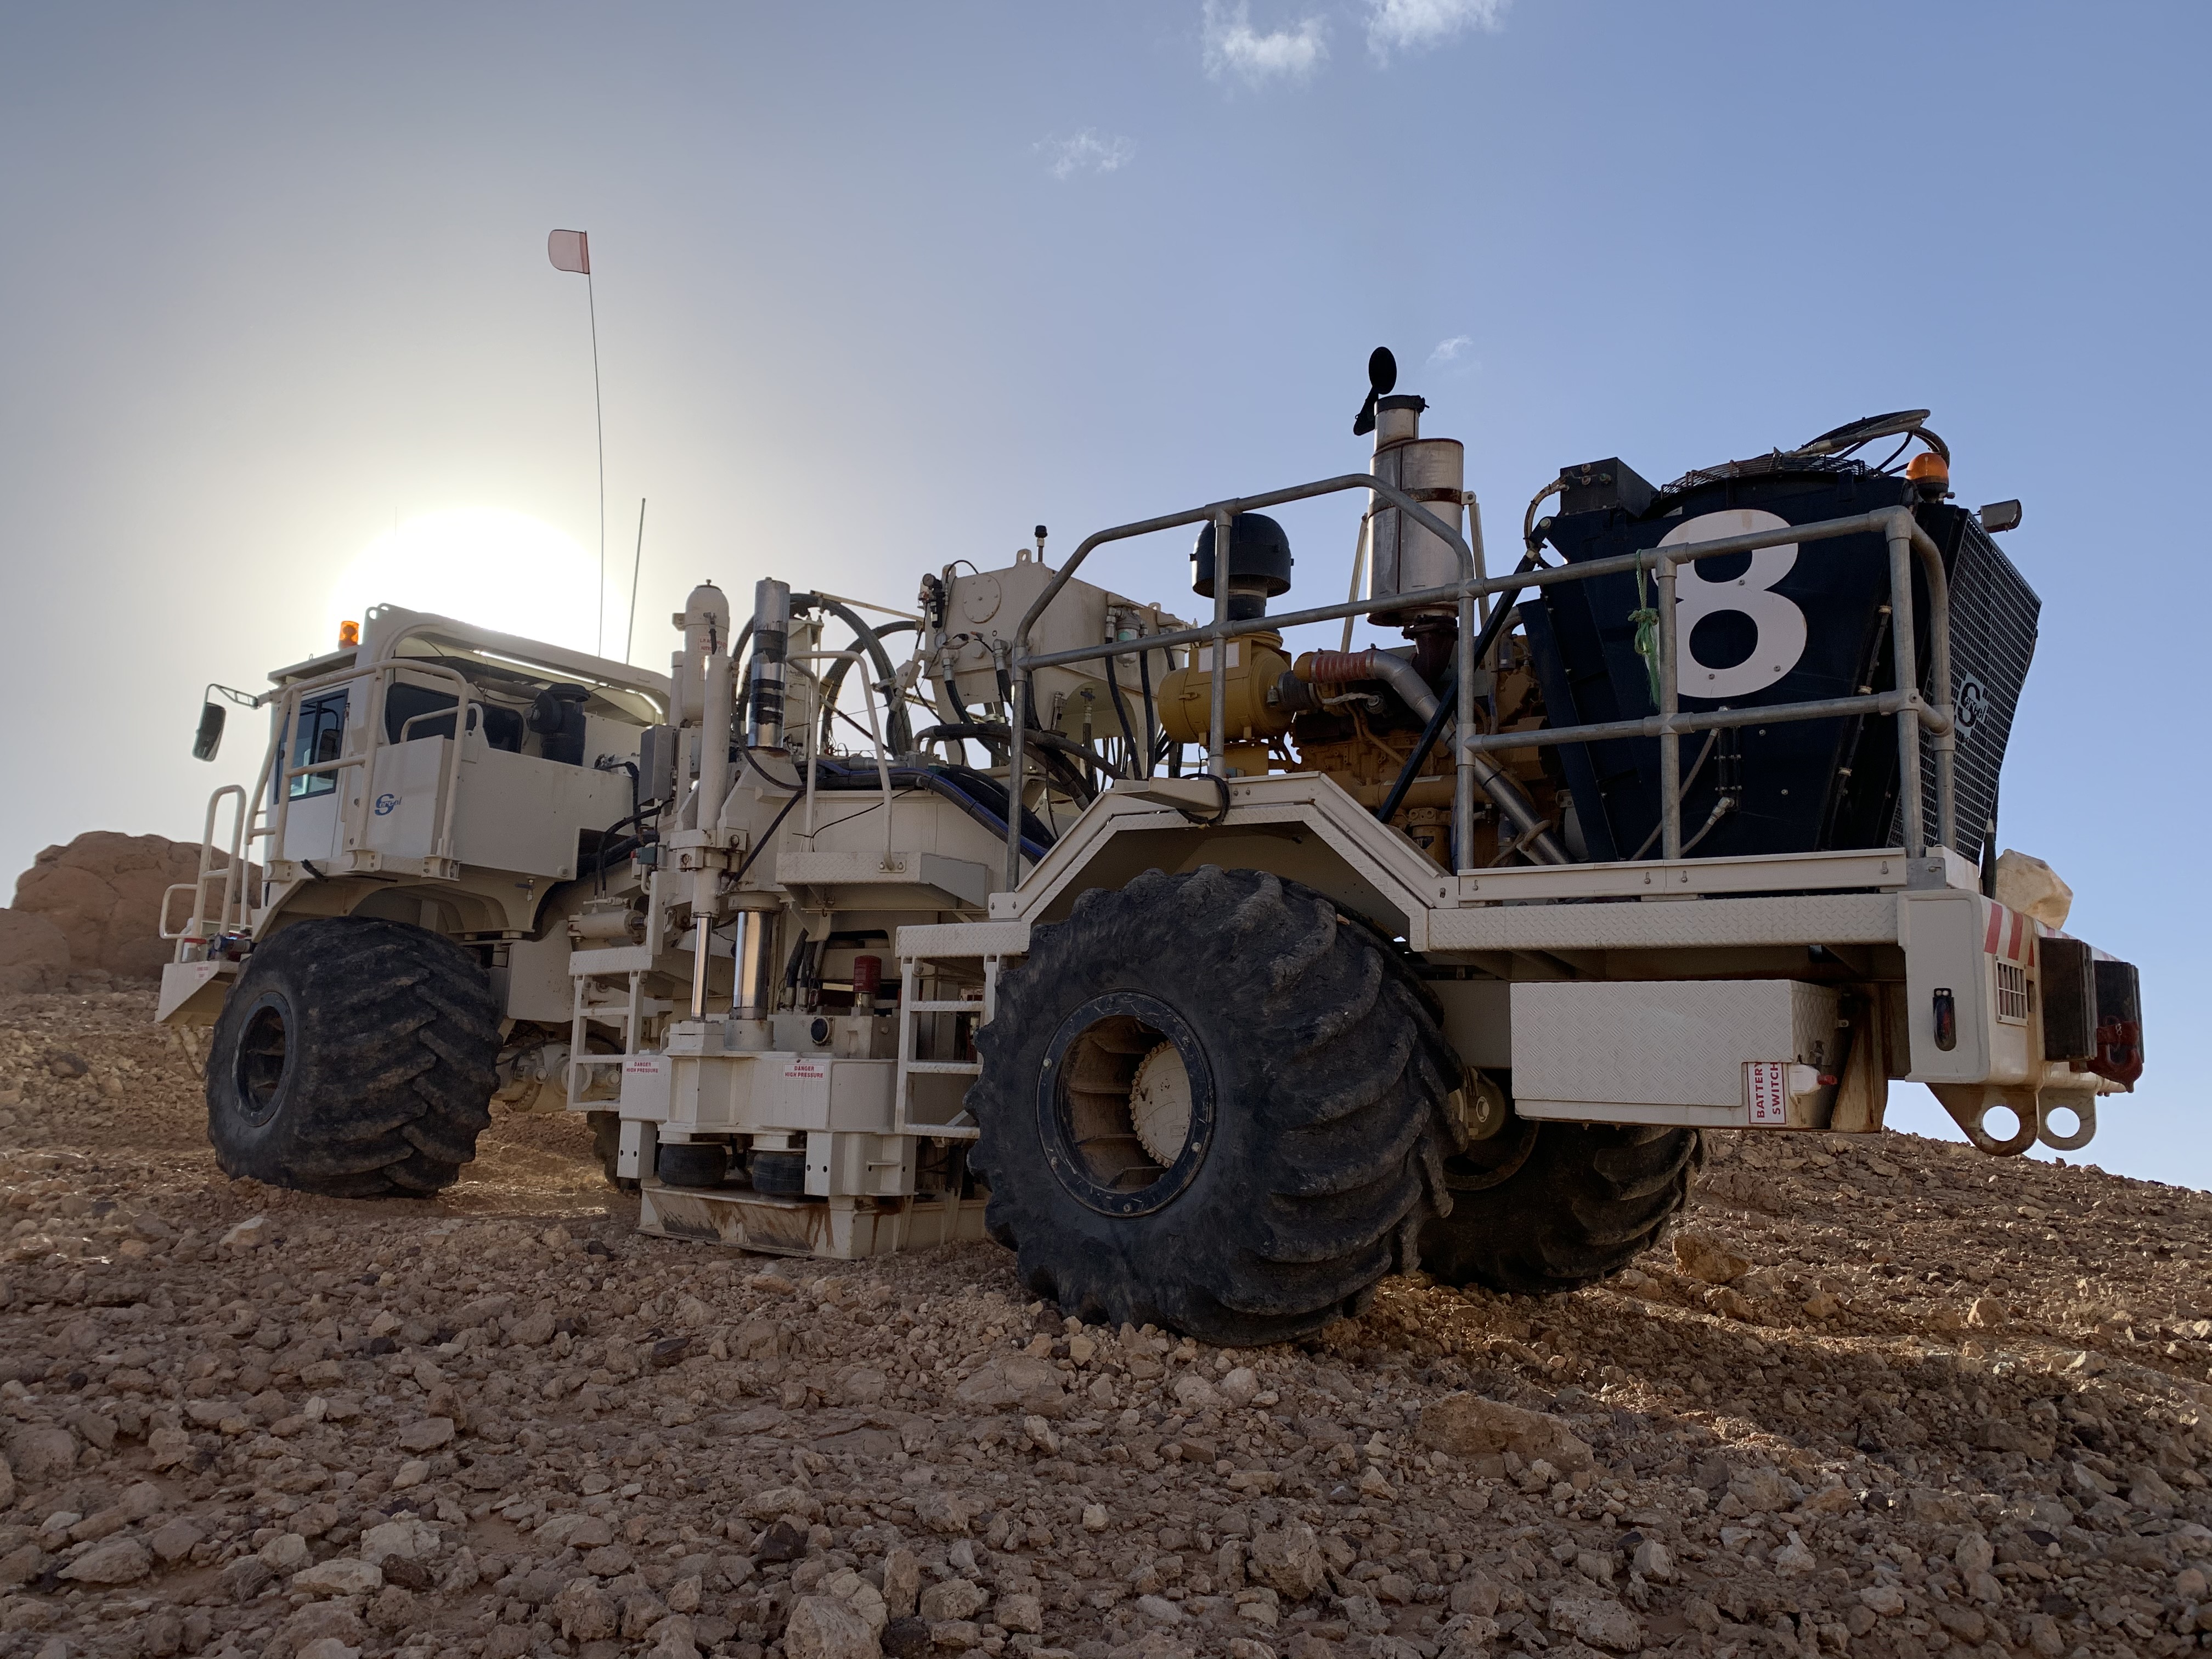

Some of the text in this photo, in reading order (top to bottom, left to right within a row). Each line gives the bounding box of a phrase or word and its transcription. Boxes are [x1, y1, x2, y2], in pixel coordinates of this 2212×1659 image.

[1645, 509, 1807, 698] 8
[1957, 682, 1987, 727] Sercel
[1754, 1062, 1765, 1118] BATTERY
[1770, 1062, 1781, 1115] SWITCH
